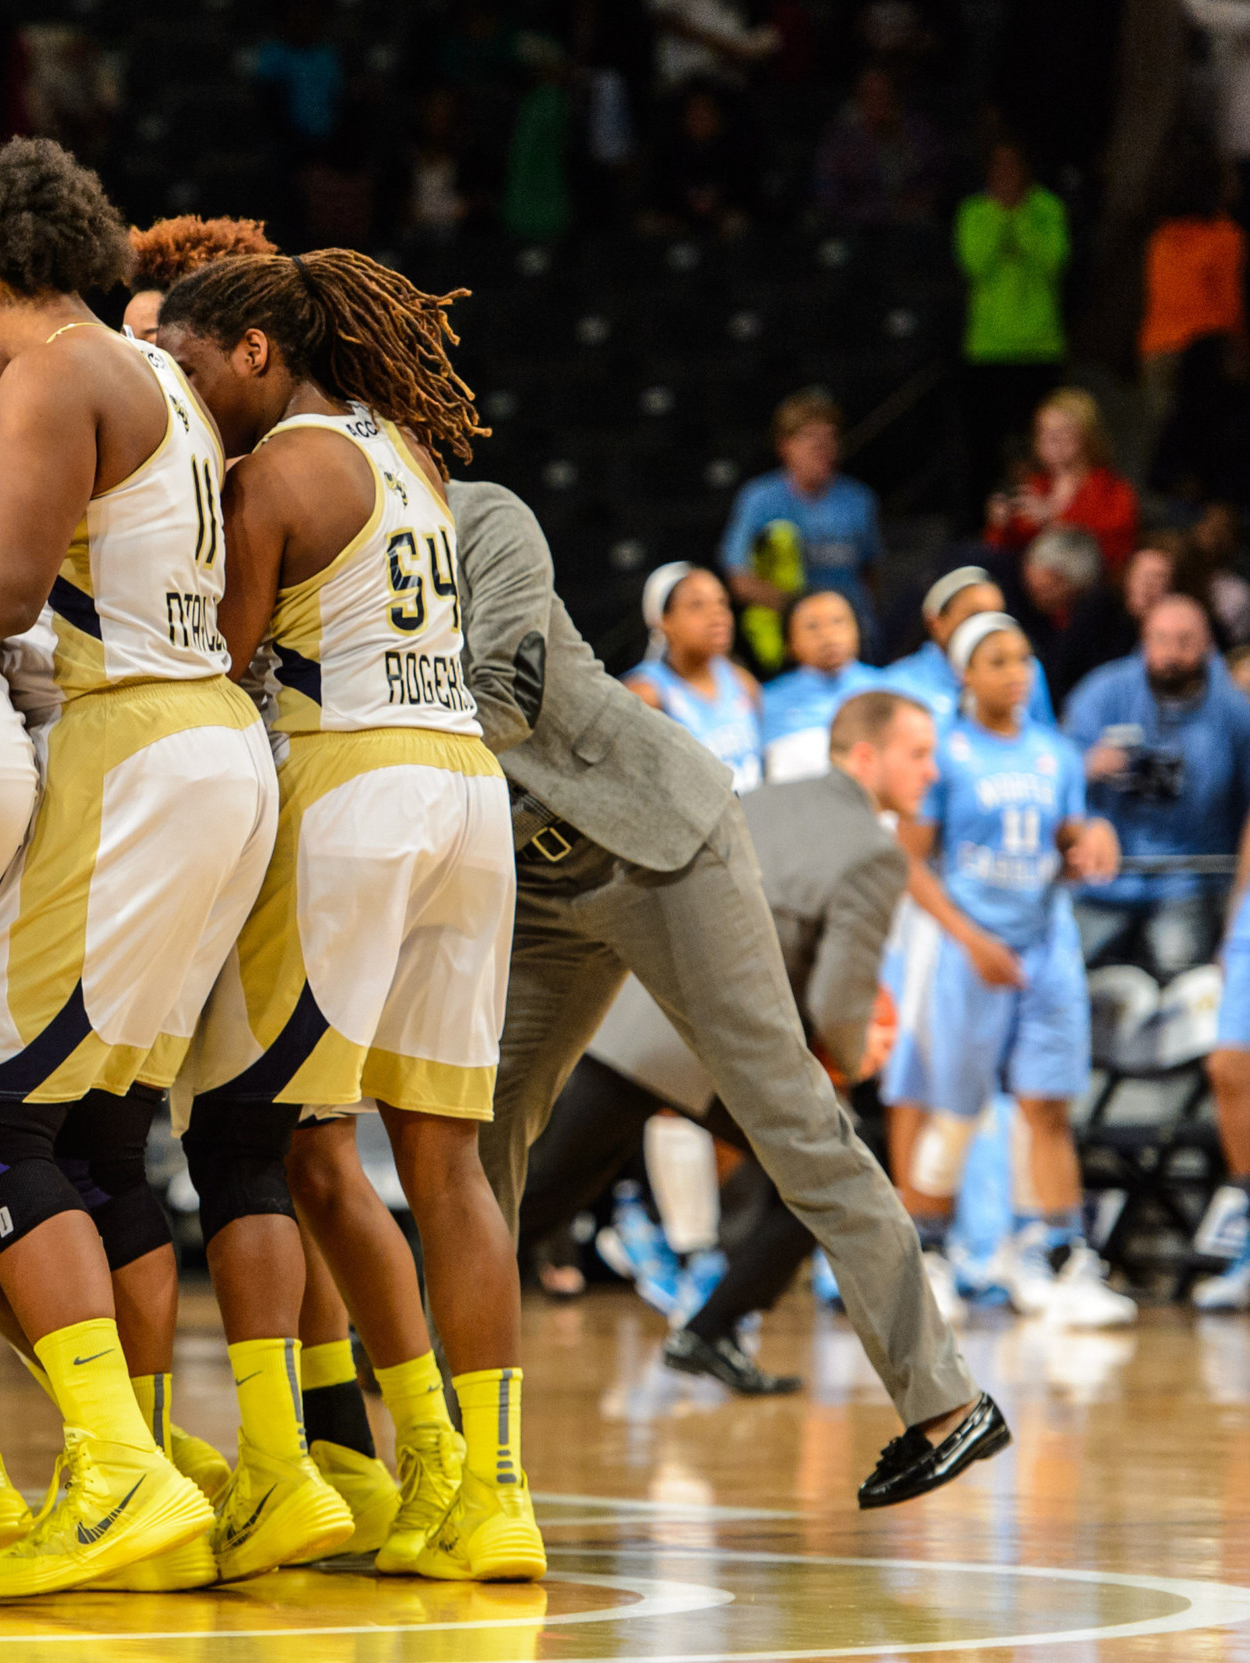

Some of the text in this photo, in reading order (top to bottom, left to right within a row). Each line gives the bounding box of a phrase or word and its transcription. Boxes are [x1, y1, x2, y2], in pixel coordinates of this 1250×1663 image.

[347, 422, 378, 438] ACC
[191, 453, 216, 571] 11
[385, 526, 461, 636] 54
